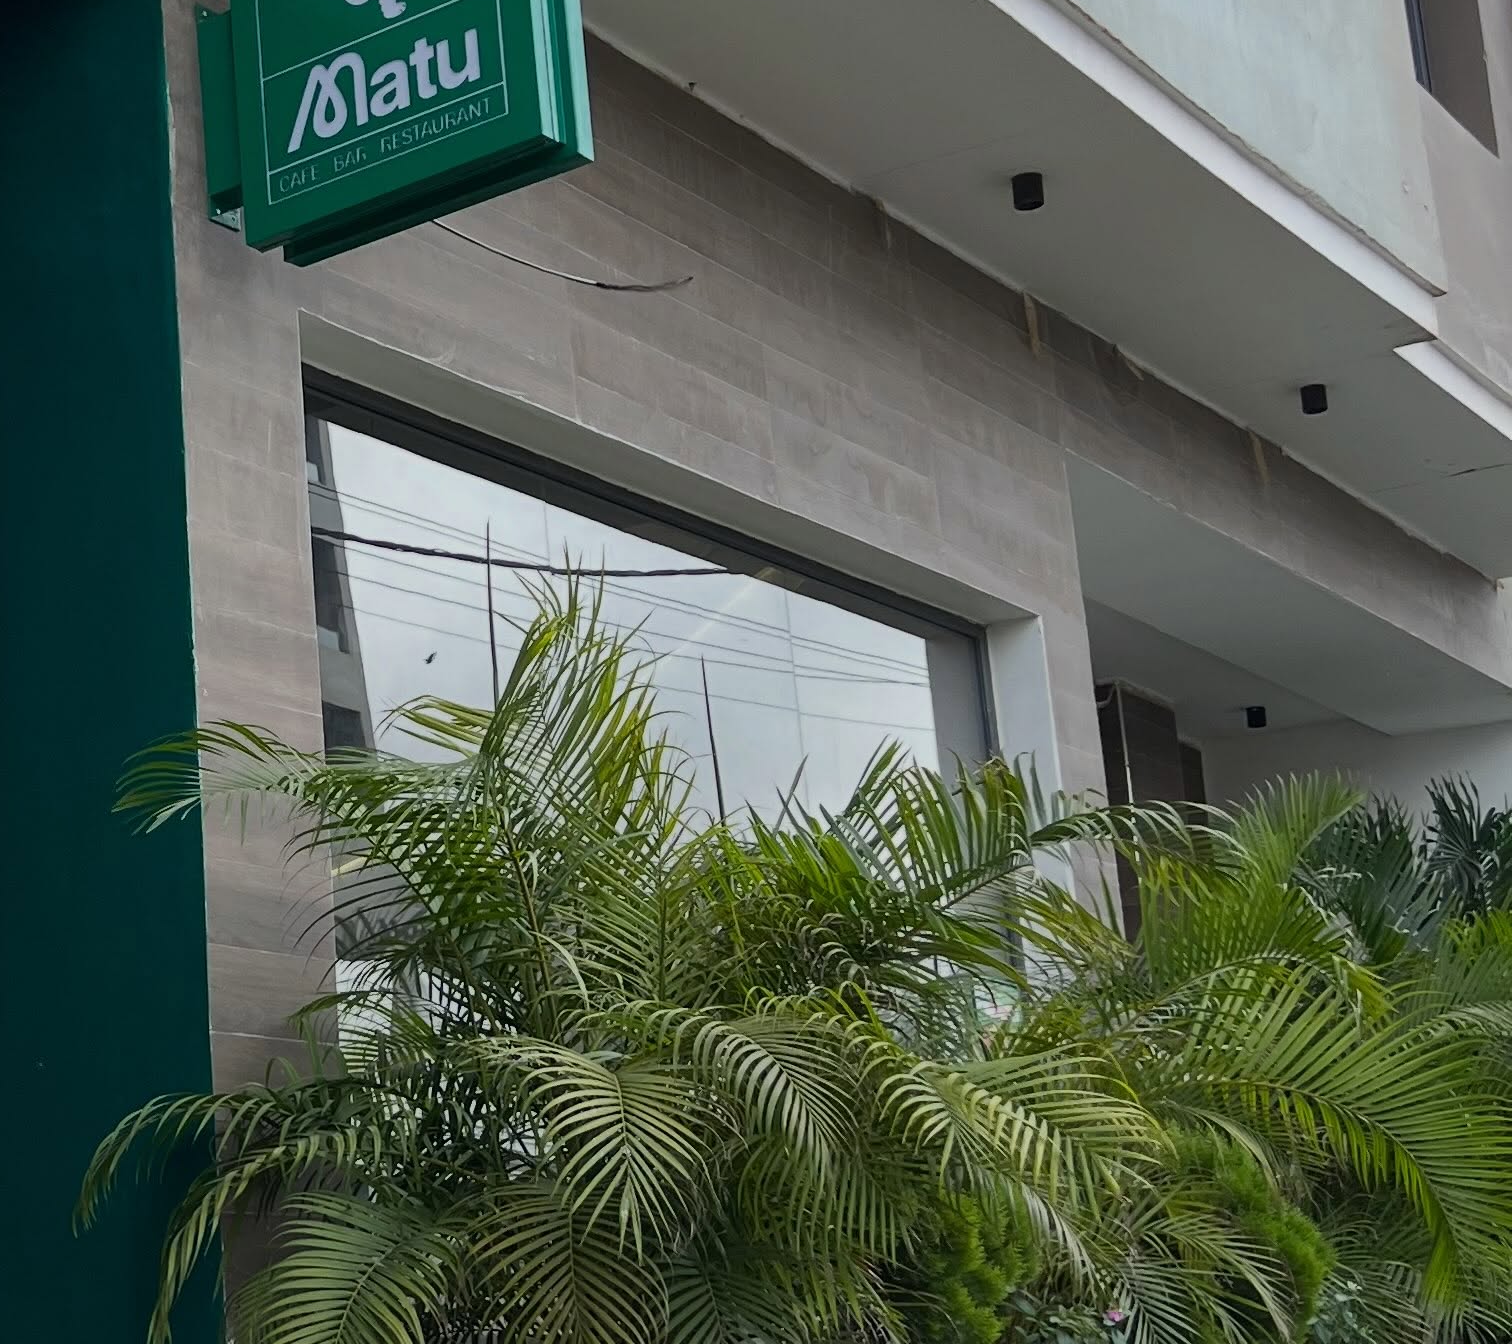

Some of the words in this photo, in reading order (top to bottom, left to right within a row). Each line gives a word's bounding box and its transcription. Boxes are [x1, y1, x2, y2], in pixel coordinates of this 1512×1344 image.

[279, 164, 319, 193] CAFE
[333, 146, 367, 173] BAR
[379, 97, 492, 154] RESTAURANT
[287, 28, 481, 154] Matu
